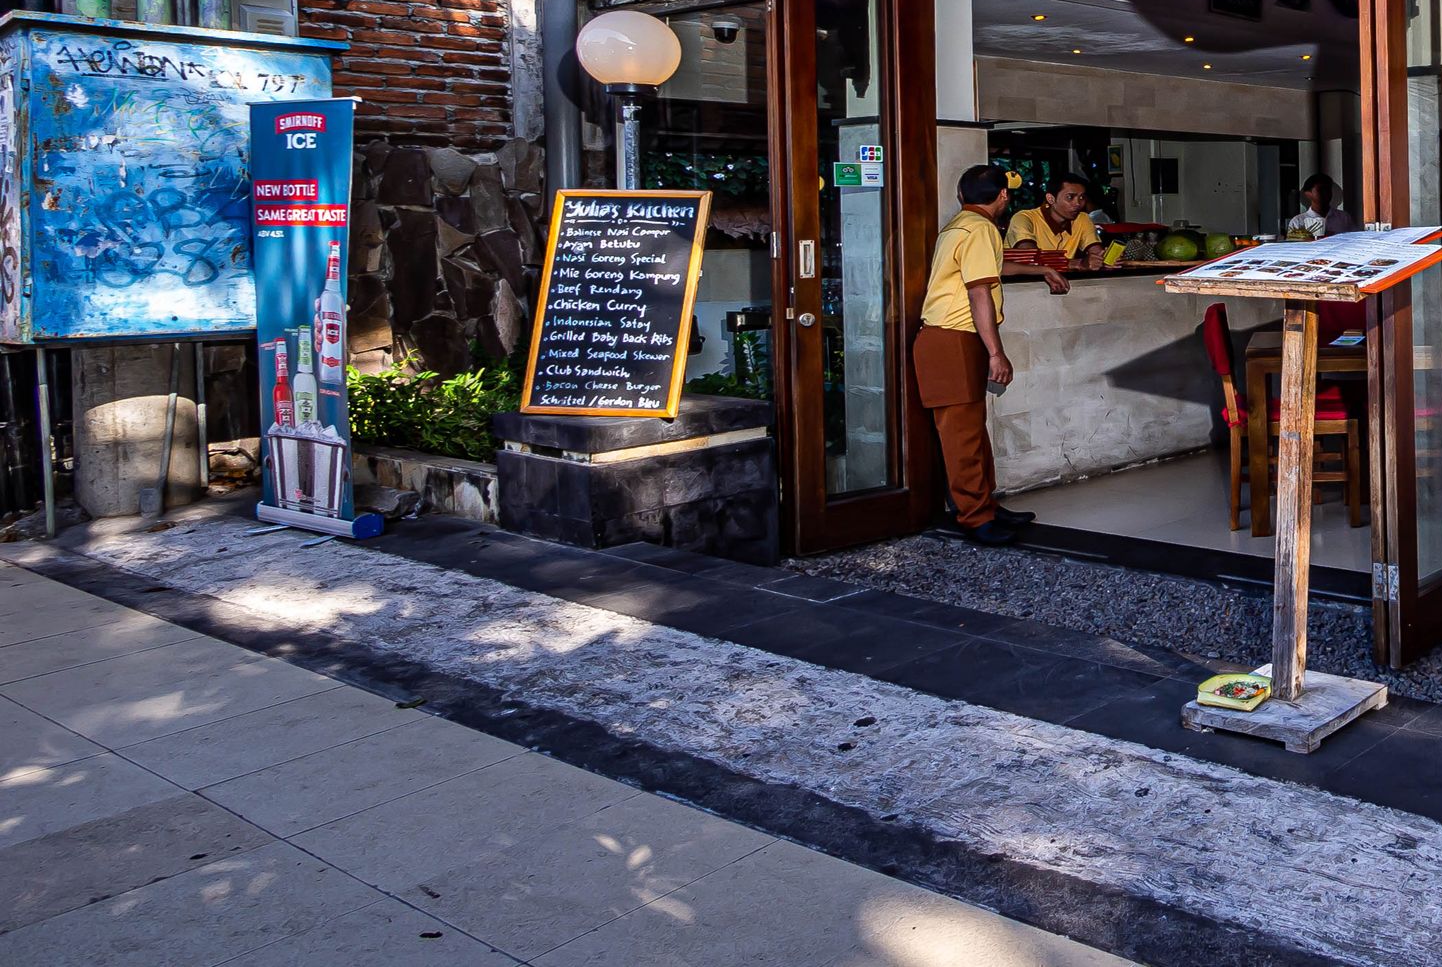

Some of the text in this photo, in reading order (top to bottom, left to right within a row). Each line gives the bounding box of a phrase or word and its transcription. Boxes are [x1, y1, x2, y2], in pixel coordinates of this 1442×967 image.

[280, 115, 323, 130] SMIRNOFF
[286, 133, 317, 149] ICE
[256, 183, 316, 196] NEW BOTTLE
[257, 208, 347, 222] SAME GREAT TASTE
[564, 200, 695, 219] Yulia's Kitchen
[566, 227, 602, 237] Balinese
[607, 227, 629, 237] Nasi
[600, 239, 641, 249] Betutu
[562, 252, 667, 266] Nasi Goreng Special
[559, 268, 681, 285] Mie Goreng Kampung
[557, 283, 643, 299] Beef Rendang
[554, 299, 648, 318] Chicken Curry
[553, 315, 651, 332] Indonesian Satay
[550, 331, 673, 346] Grilled Baby Back Ribs
[549, 347, 670, 362] Mixed Seafood Skewer
[546, 364, 631, 378] Club Sandwich
[585, 380, 619, 390] Cheese
[625, 382, 661, 394] Burger
